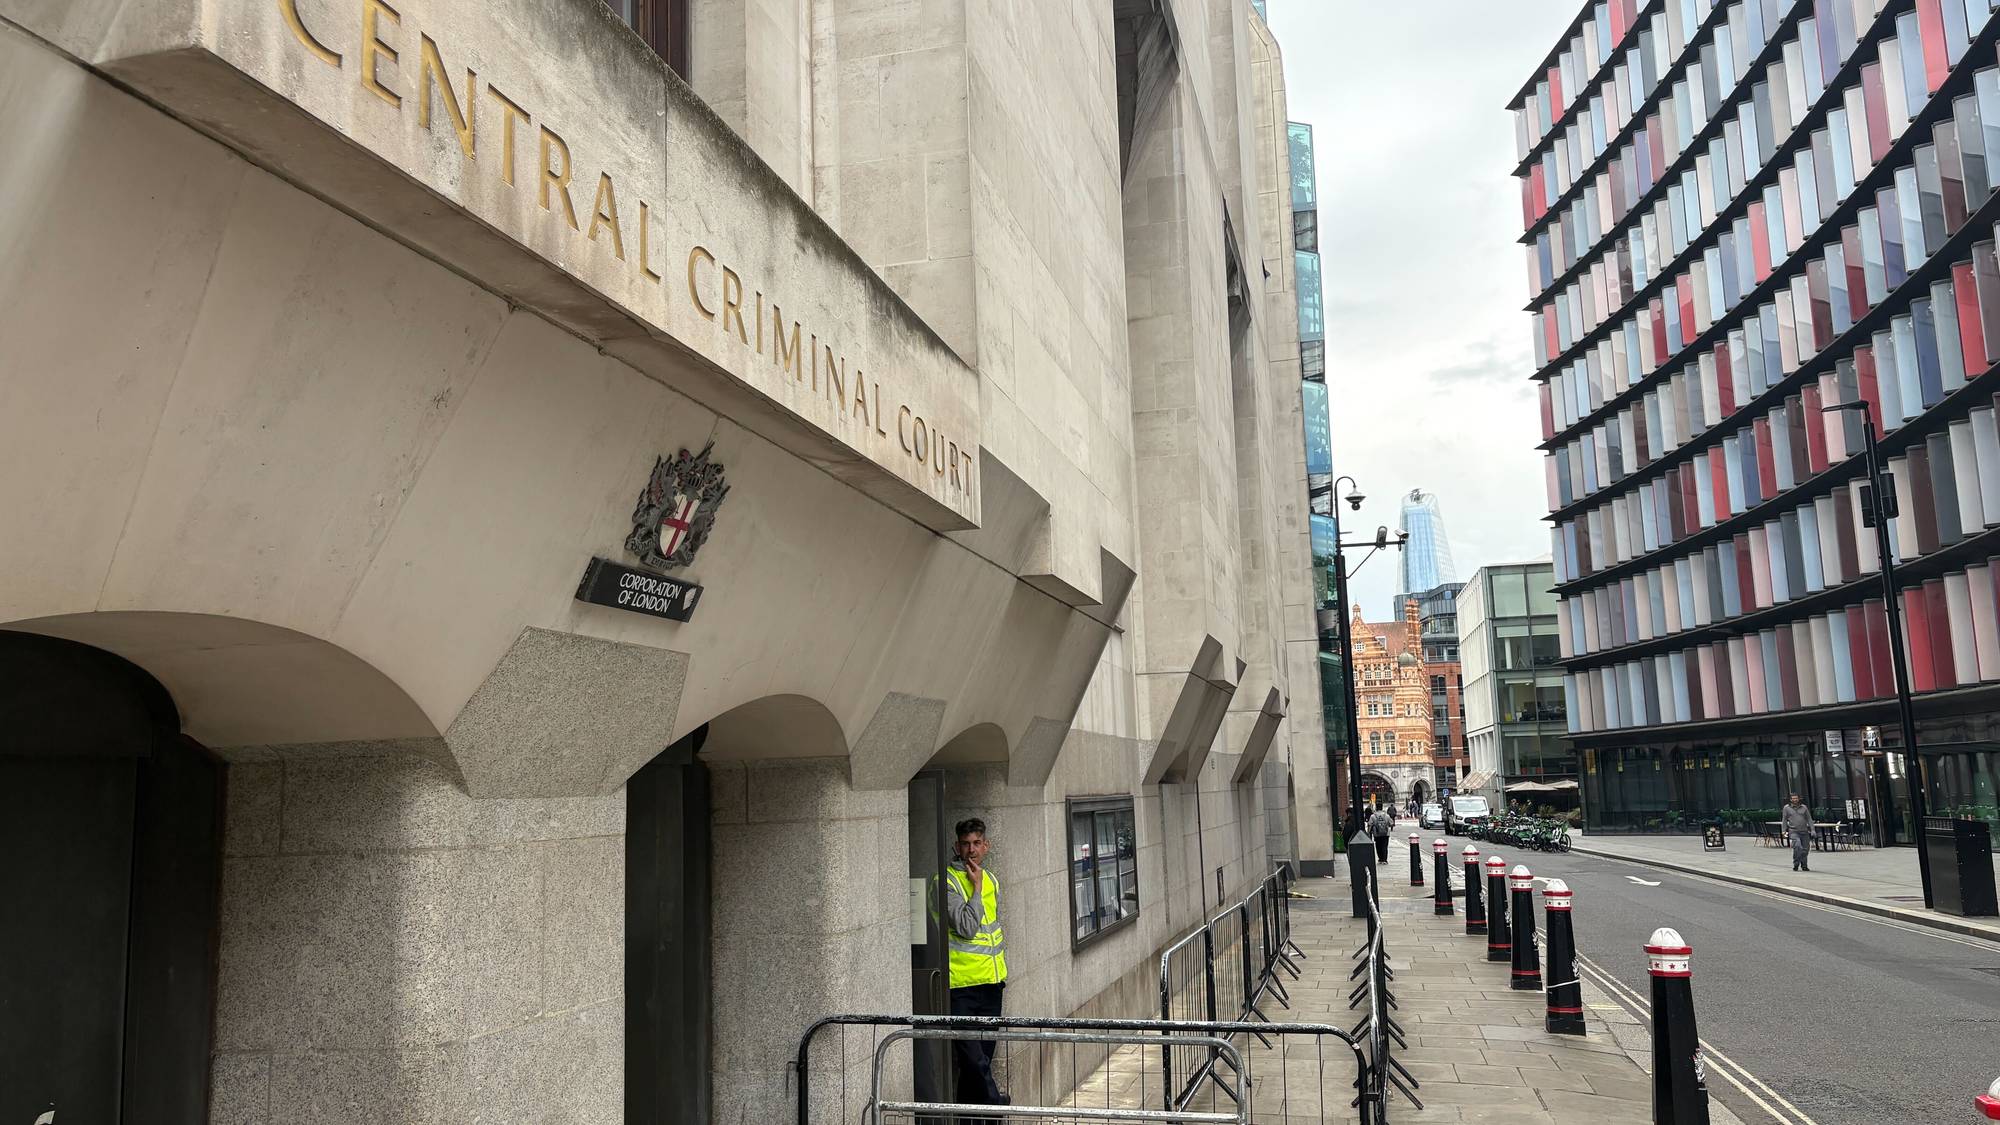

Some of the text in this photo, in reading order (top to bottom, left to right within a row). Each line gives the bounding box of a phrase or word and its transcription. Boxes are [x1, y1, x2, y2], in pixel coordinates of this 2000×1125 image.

[687, 245, 887, 439] CRIMINAL
[897, 404, 973, 497] COURT
[619, 572, 683, 599] CORPORATION
[617, 589, 672, 613] OF LONDON
